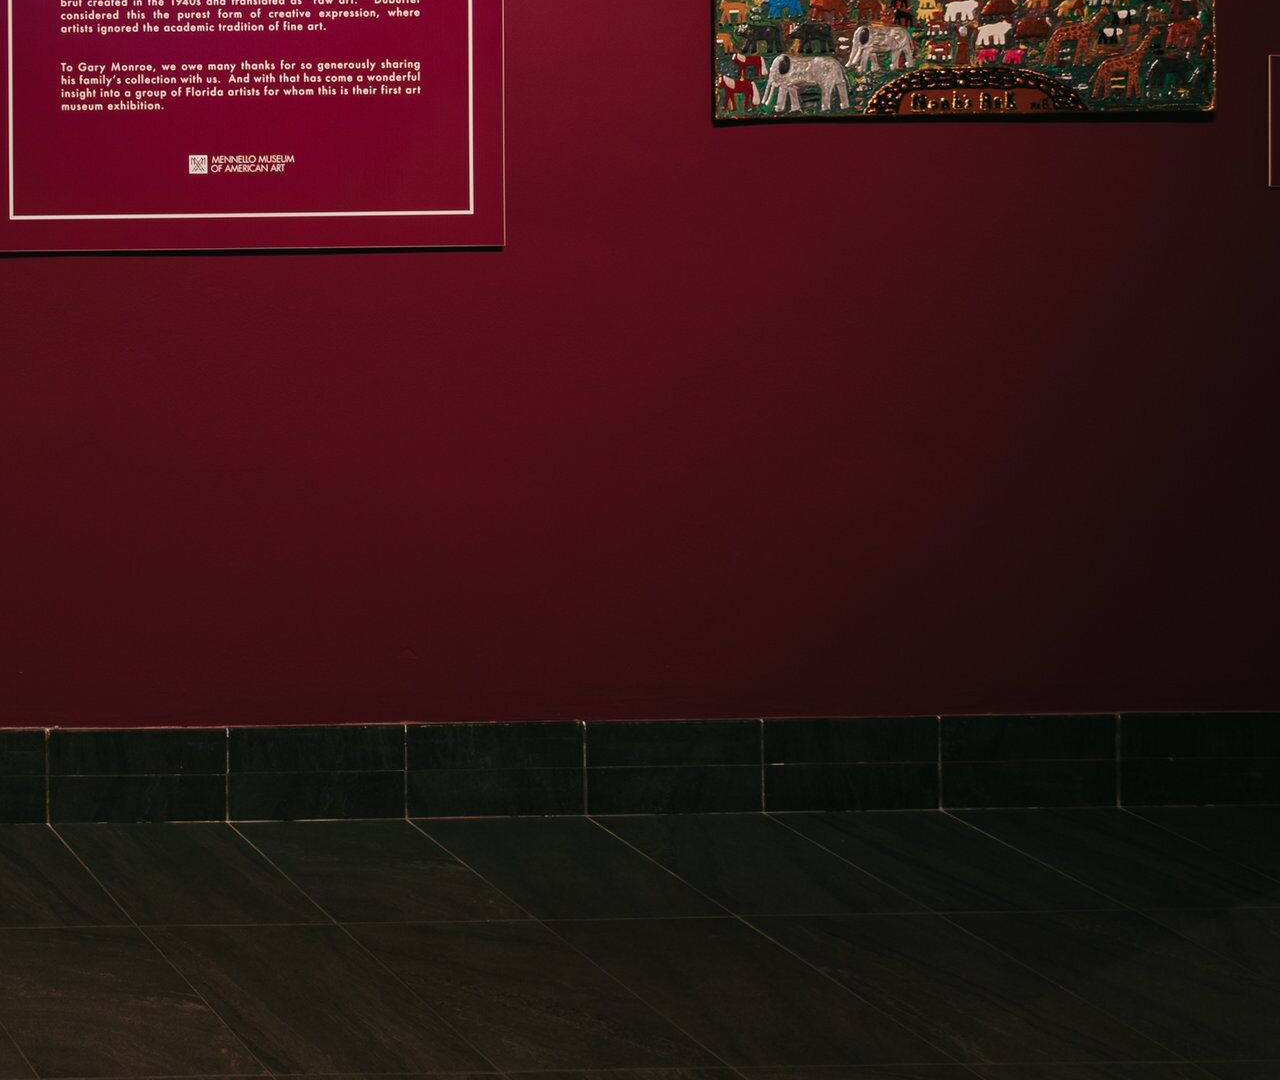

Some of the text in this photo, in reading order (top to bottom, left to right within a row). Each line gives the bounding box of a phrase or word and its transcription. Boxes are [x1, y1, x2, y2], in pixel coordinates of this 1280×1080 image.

[60, 63, 73, 72] To
[78, 62, 106, 74] Gary
[111, 62, 156, 72] Monroe,
[208, 64, 236, 73] many
[241, 60, 275, 70] thanks
[280, 59, 296, 70] for
[317, 59, 376, 72] generously
[381, 59, 420, 71] sharing
[108, 100, 164, 110] exhibition.
[211, 154, 295, 164] MENNELLO MUSEUM
[210, 163, 286, 173] OF AMERICAN ART
